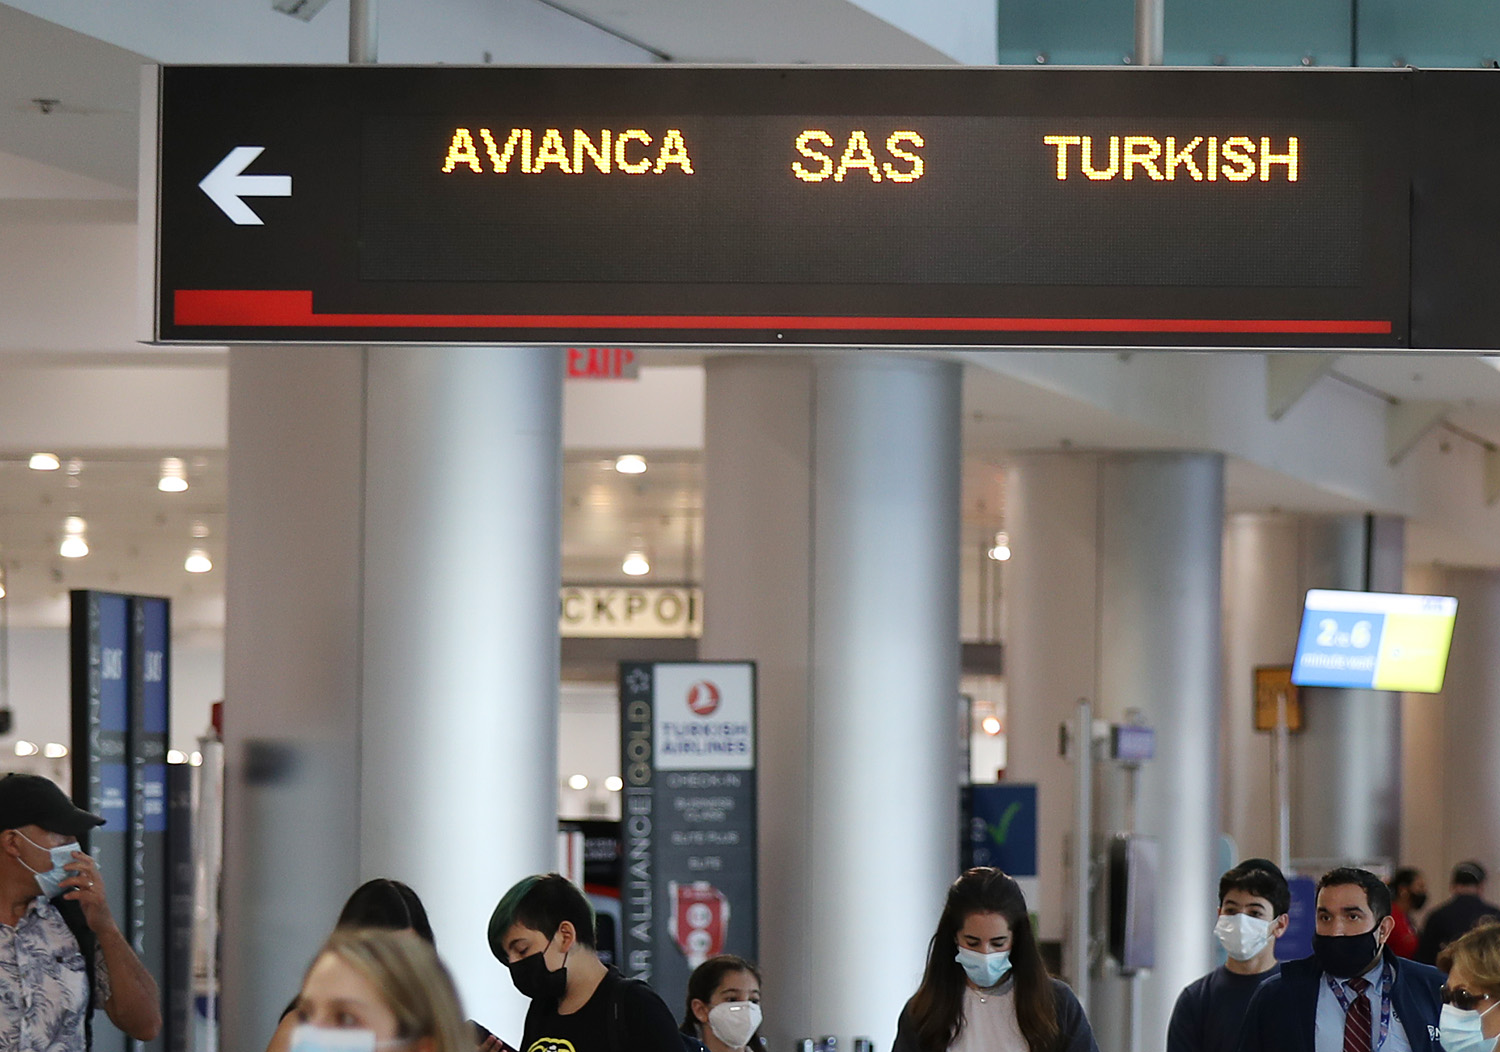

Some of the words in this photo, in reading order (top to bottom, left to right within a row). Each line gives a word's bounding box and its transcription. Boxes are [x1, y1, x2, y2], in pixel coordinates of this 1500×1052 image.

[441, 128, 695, 174] AVIANCA
[790, 129, 926, 183] SAS
[1043, 135, 1299, 182] TURKISH
